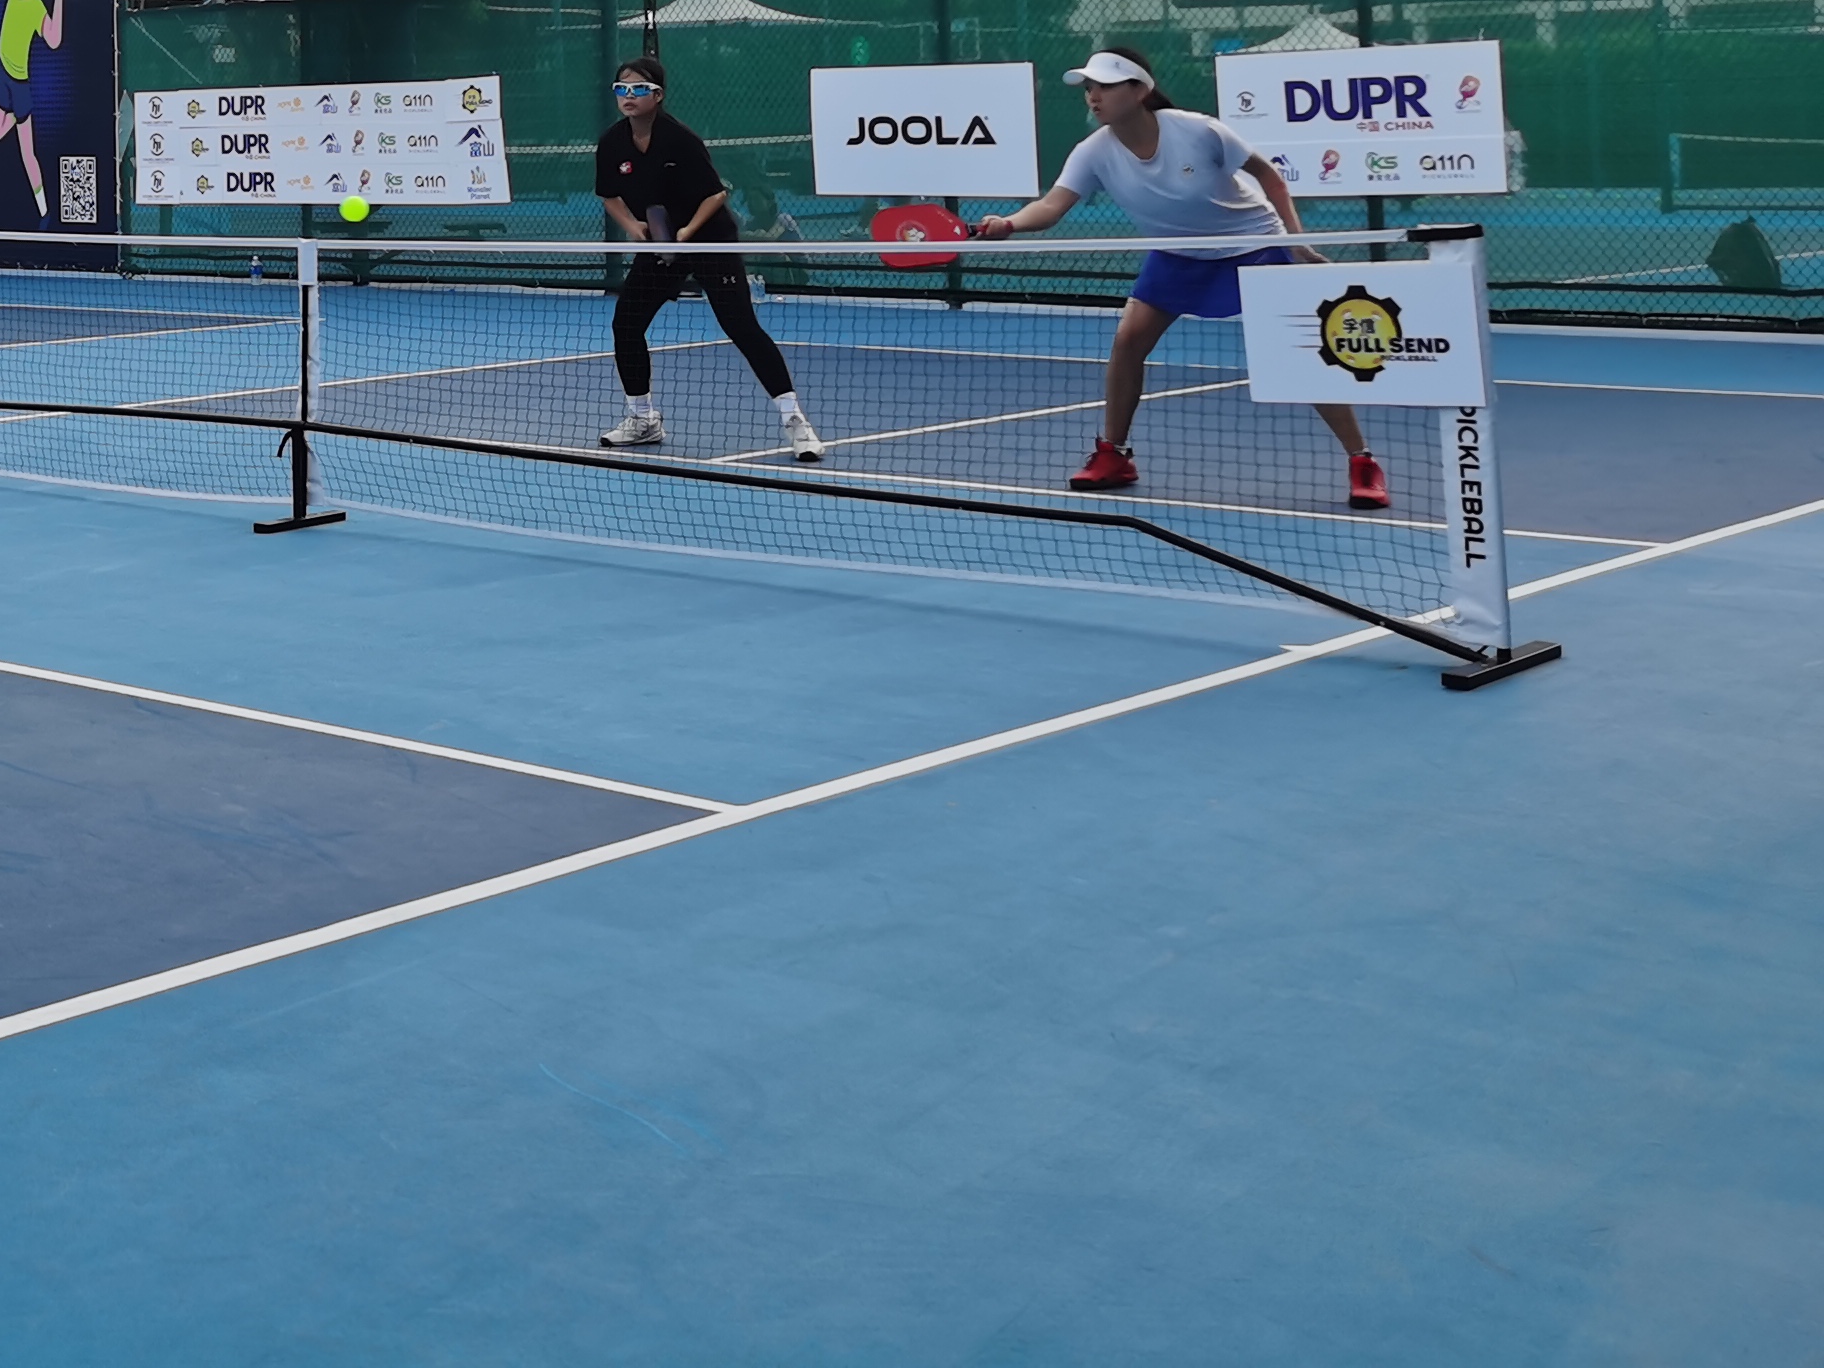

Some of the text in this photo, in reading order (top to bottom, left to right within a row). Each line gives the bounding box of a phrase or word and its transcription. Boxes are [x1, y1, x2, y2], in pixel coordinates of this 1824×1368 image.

[218, 95, 266, 116] DUPR
[1283, 75, 1432, 123] DUPR
[846, 115, 997, 146] JOOLA
[1356, 120, 1434, 132] 中国 CHINA
[221, 133, 271, 154] DUPR
[469, 140, 495, 157] 富山
[226, 171, 276, 192] DUPR
[1336, 338, 1450, 353] FULL SEND
